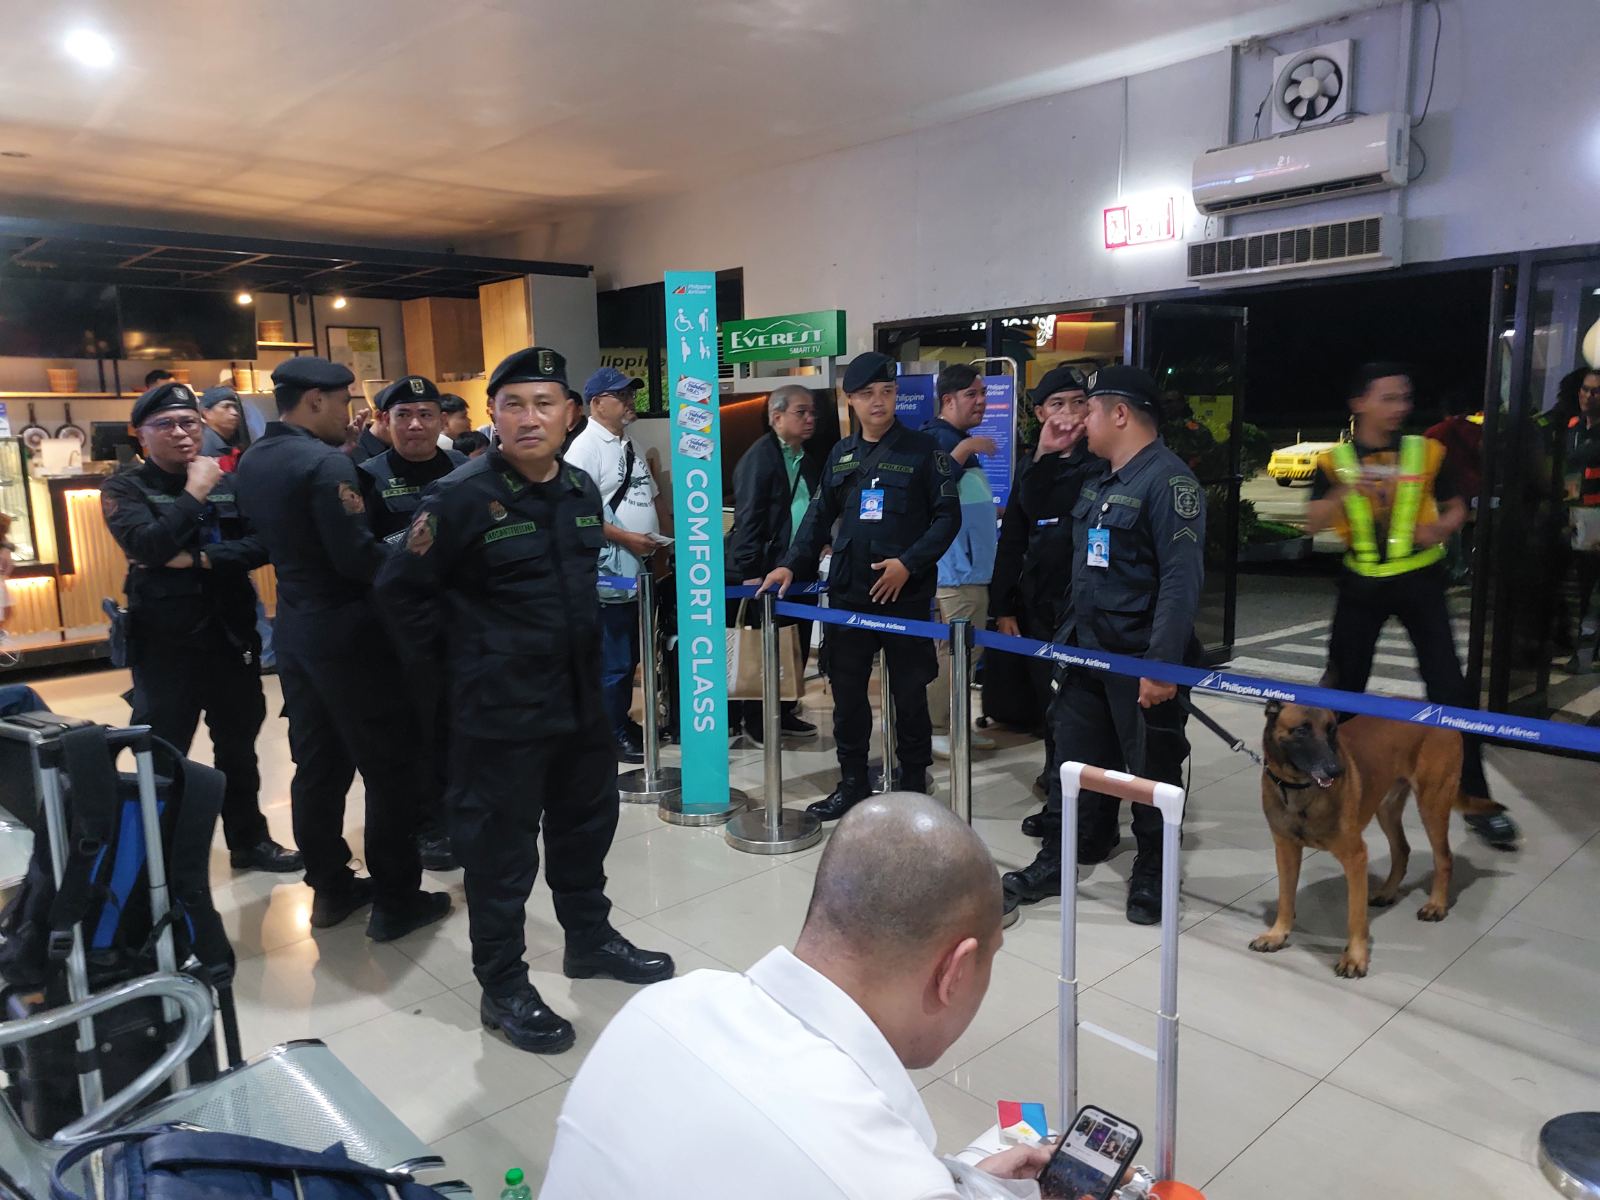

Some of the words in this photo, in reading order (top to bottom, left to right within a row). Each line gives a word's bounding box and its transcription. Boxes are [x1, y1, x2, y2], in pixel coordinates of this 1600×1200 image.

[731, 329, 824, 349] EVEREST
[789, 347, 810, 355] SMART
[812, 345, 821, 353] TV
[896, 393, 924, 402] hilippine
[896, 402, 917, 410] irlines
[686, 469, 712, 626] COMFORT
[860, 619, 886, 628] Philippine
[886, 622, 906, 631] Airlines
[1052, 651, 1085, 665] Philippine
[1085, 658, 1111, 669] Airlines
[691, 636, 716, 733] CLASS
[1220, 681, 1262, 696] Philippine
[1262, 688, 1296, 701] Airlines
[1441, 716, 1495, 733] Philippine
[1496, 725, 1541, 740] Airlines
